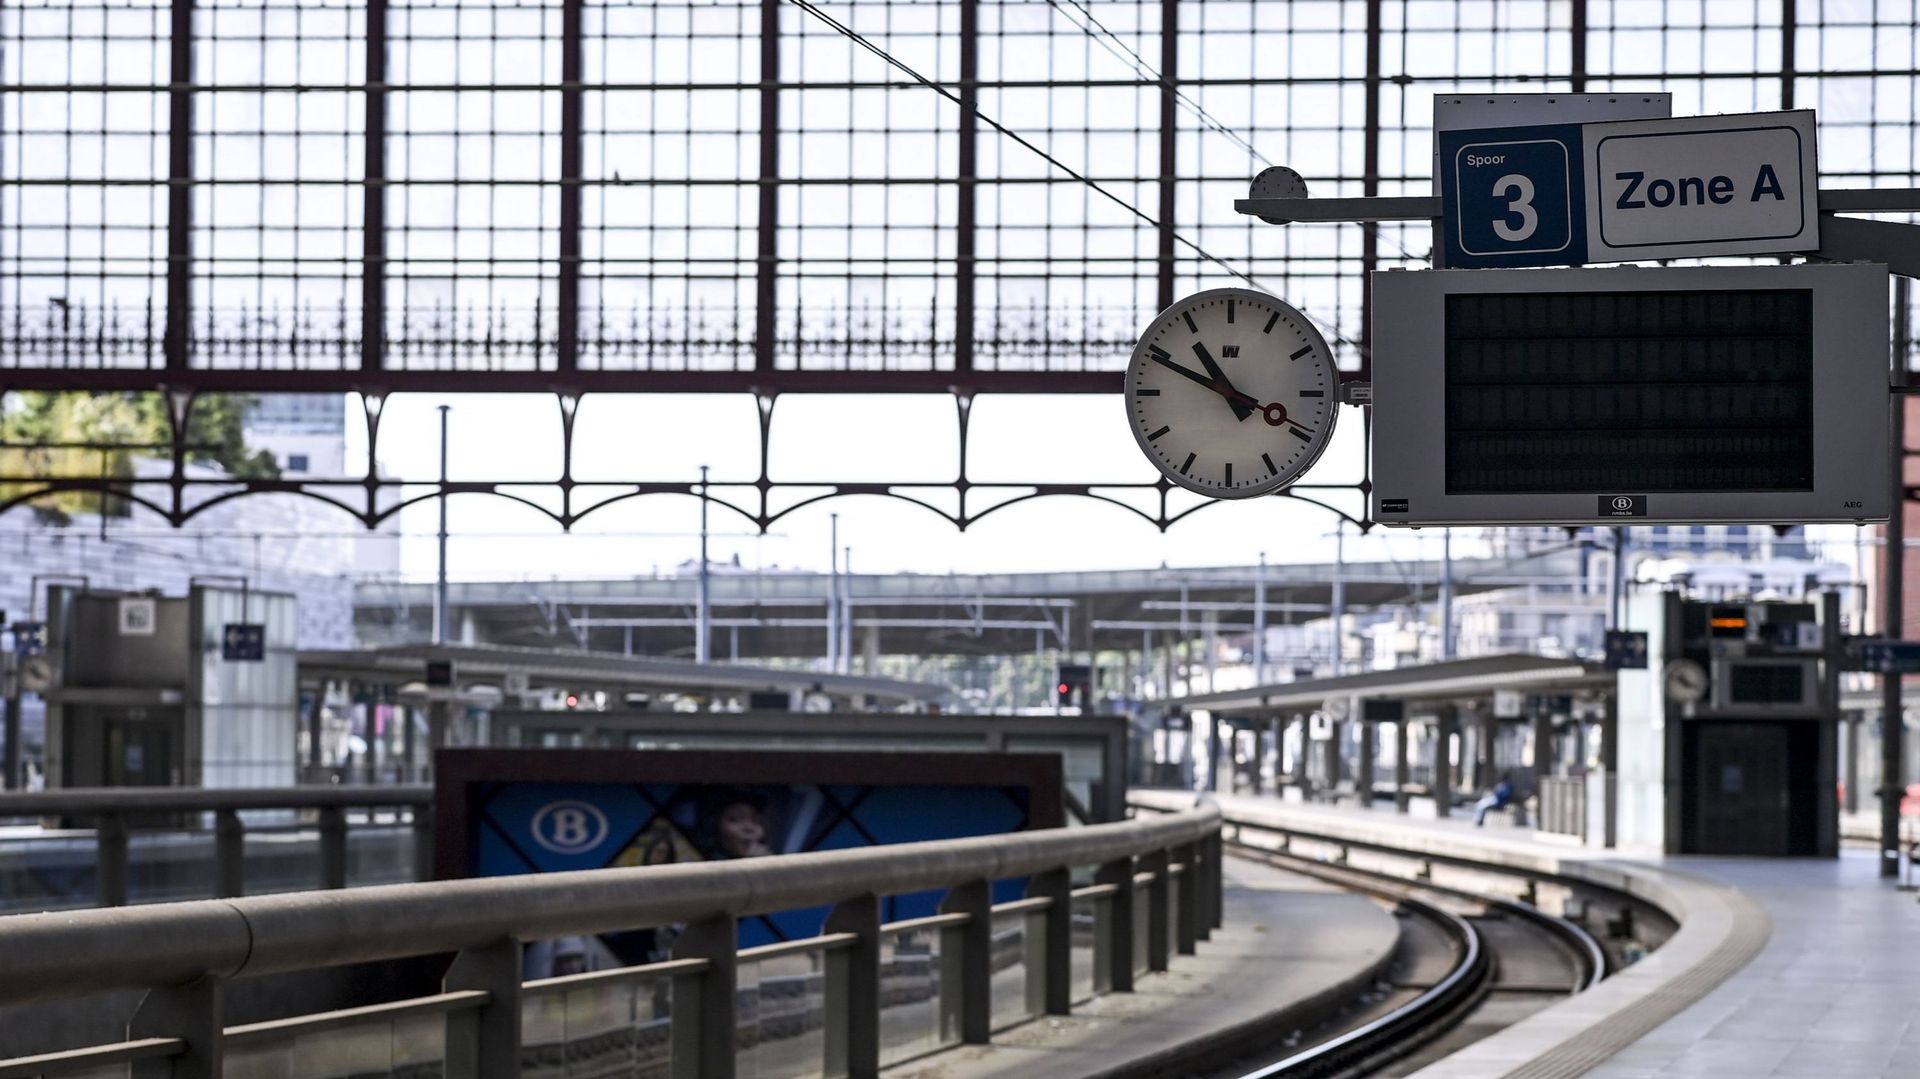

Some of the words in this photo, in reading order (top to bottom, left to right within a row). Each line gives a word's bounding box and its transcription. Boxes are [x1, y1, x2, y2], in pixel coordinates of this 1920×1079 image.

[1467, 154, 1506, 168] Spoor
[1615, 171, 1735, 209] Zone
[1750, 164, 1786, 202] A
[1492, 173, 1538, 242] 3
[1617, 498, 1627, 508] B
[1843, 501, 1863, 509] AEG
[554, 808, 588, 845] B
